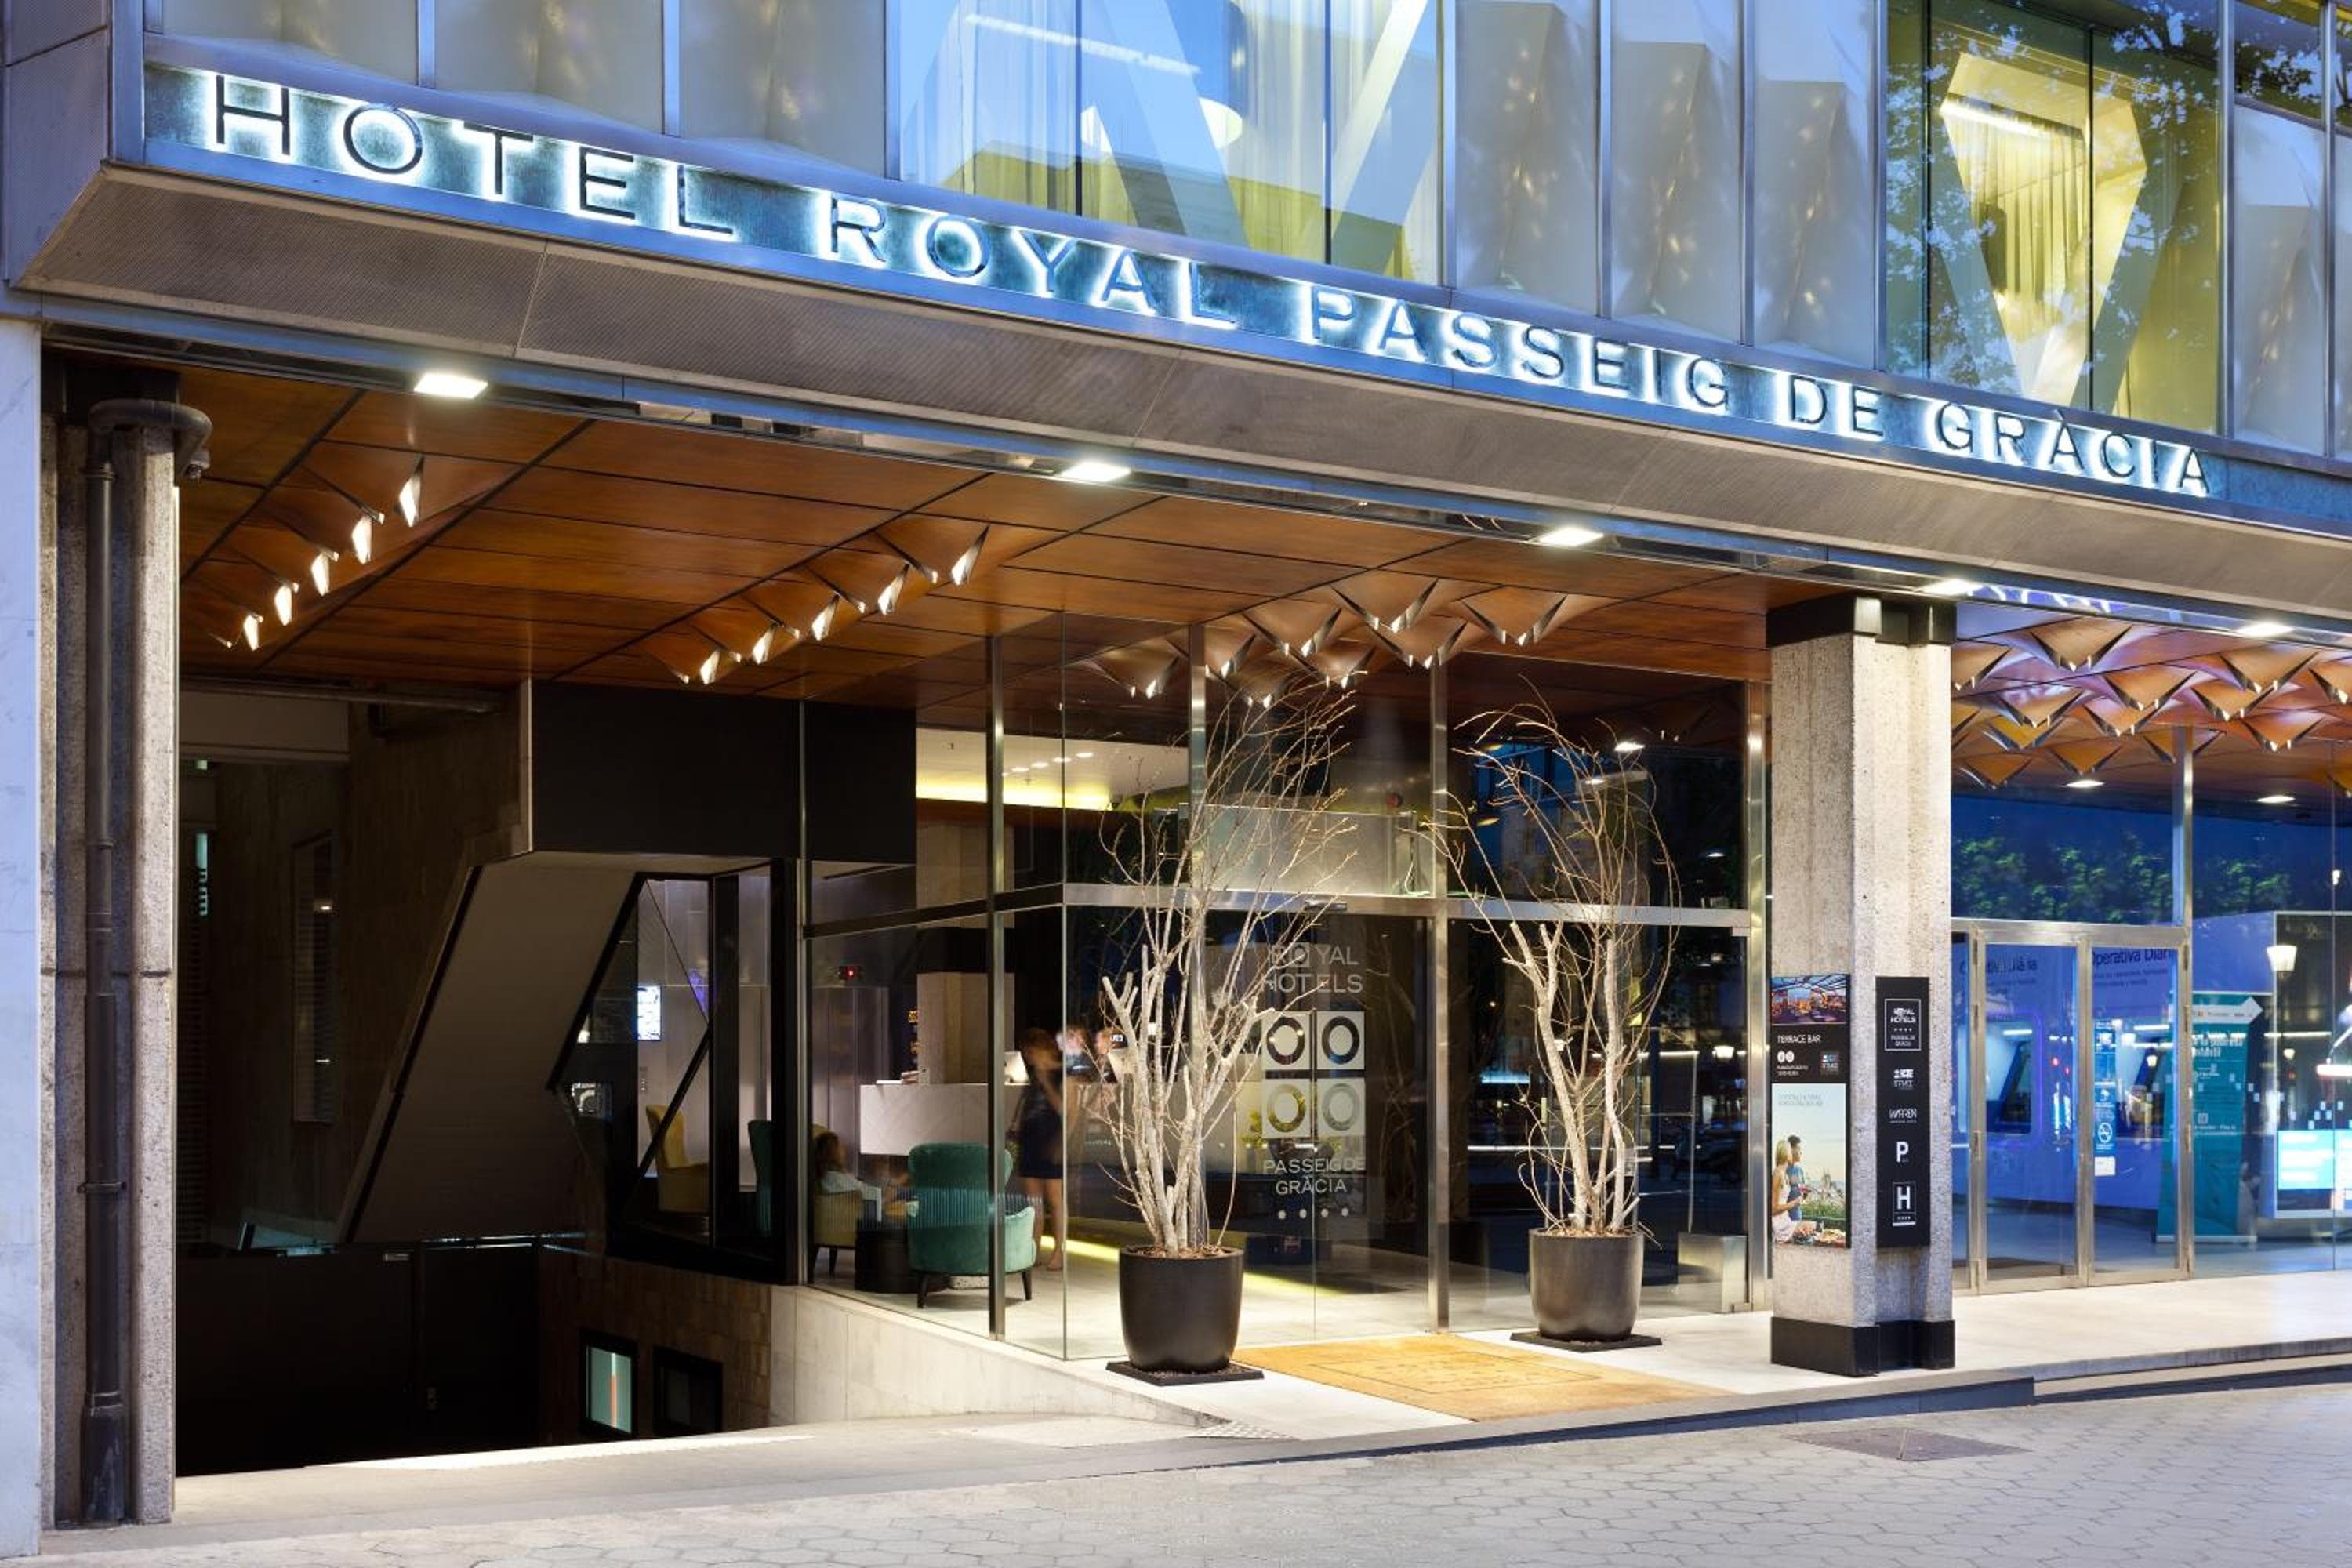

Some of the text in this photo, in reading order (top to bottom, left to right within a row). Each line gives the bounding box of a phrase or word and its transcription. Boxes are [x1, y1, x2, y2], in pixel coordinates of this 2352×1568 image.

[213, 74, 2209, 495] HOTEL ROYAL PASSEIG DE GRÀCIA
[1271, 942, 1359, 967] ROYAL
[1262, 973, 1363, 993] HOTELS
[1777, 1034, 1822, 1044] TERRACE BAR
[1896, 1141, 1910, 1163] P
[1263, 1156, 1366, 1174] PASSEIG DE
[1896, 1185, 1911, 1210] H
